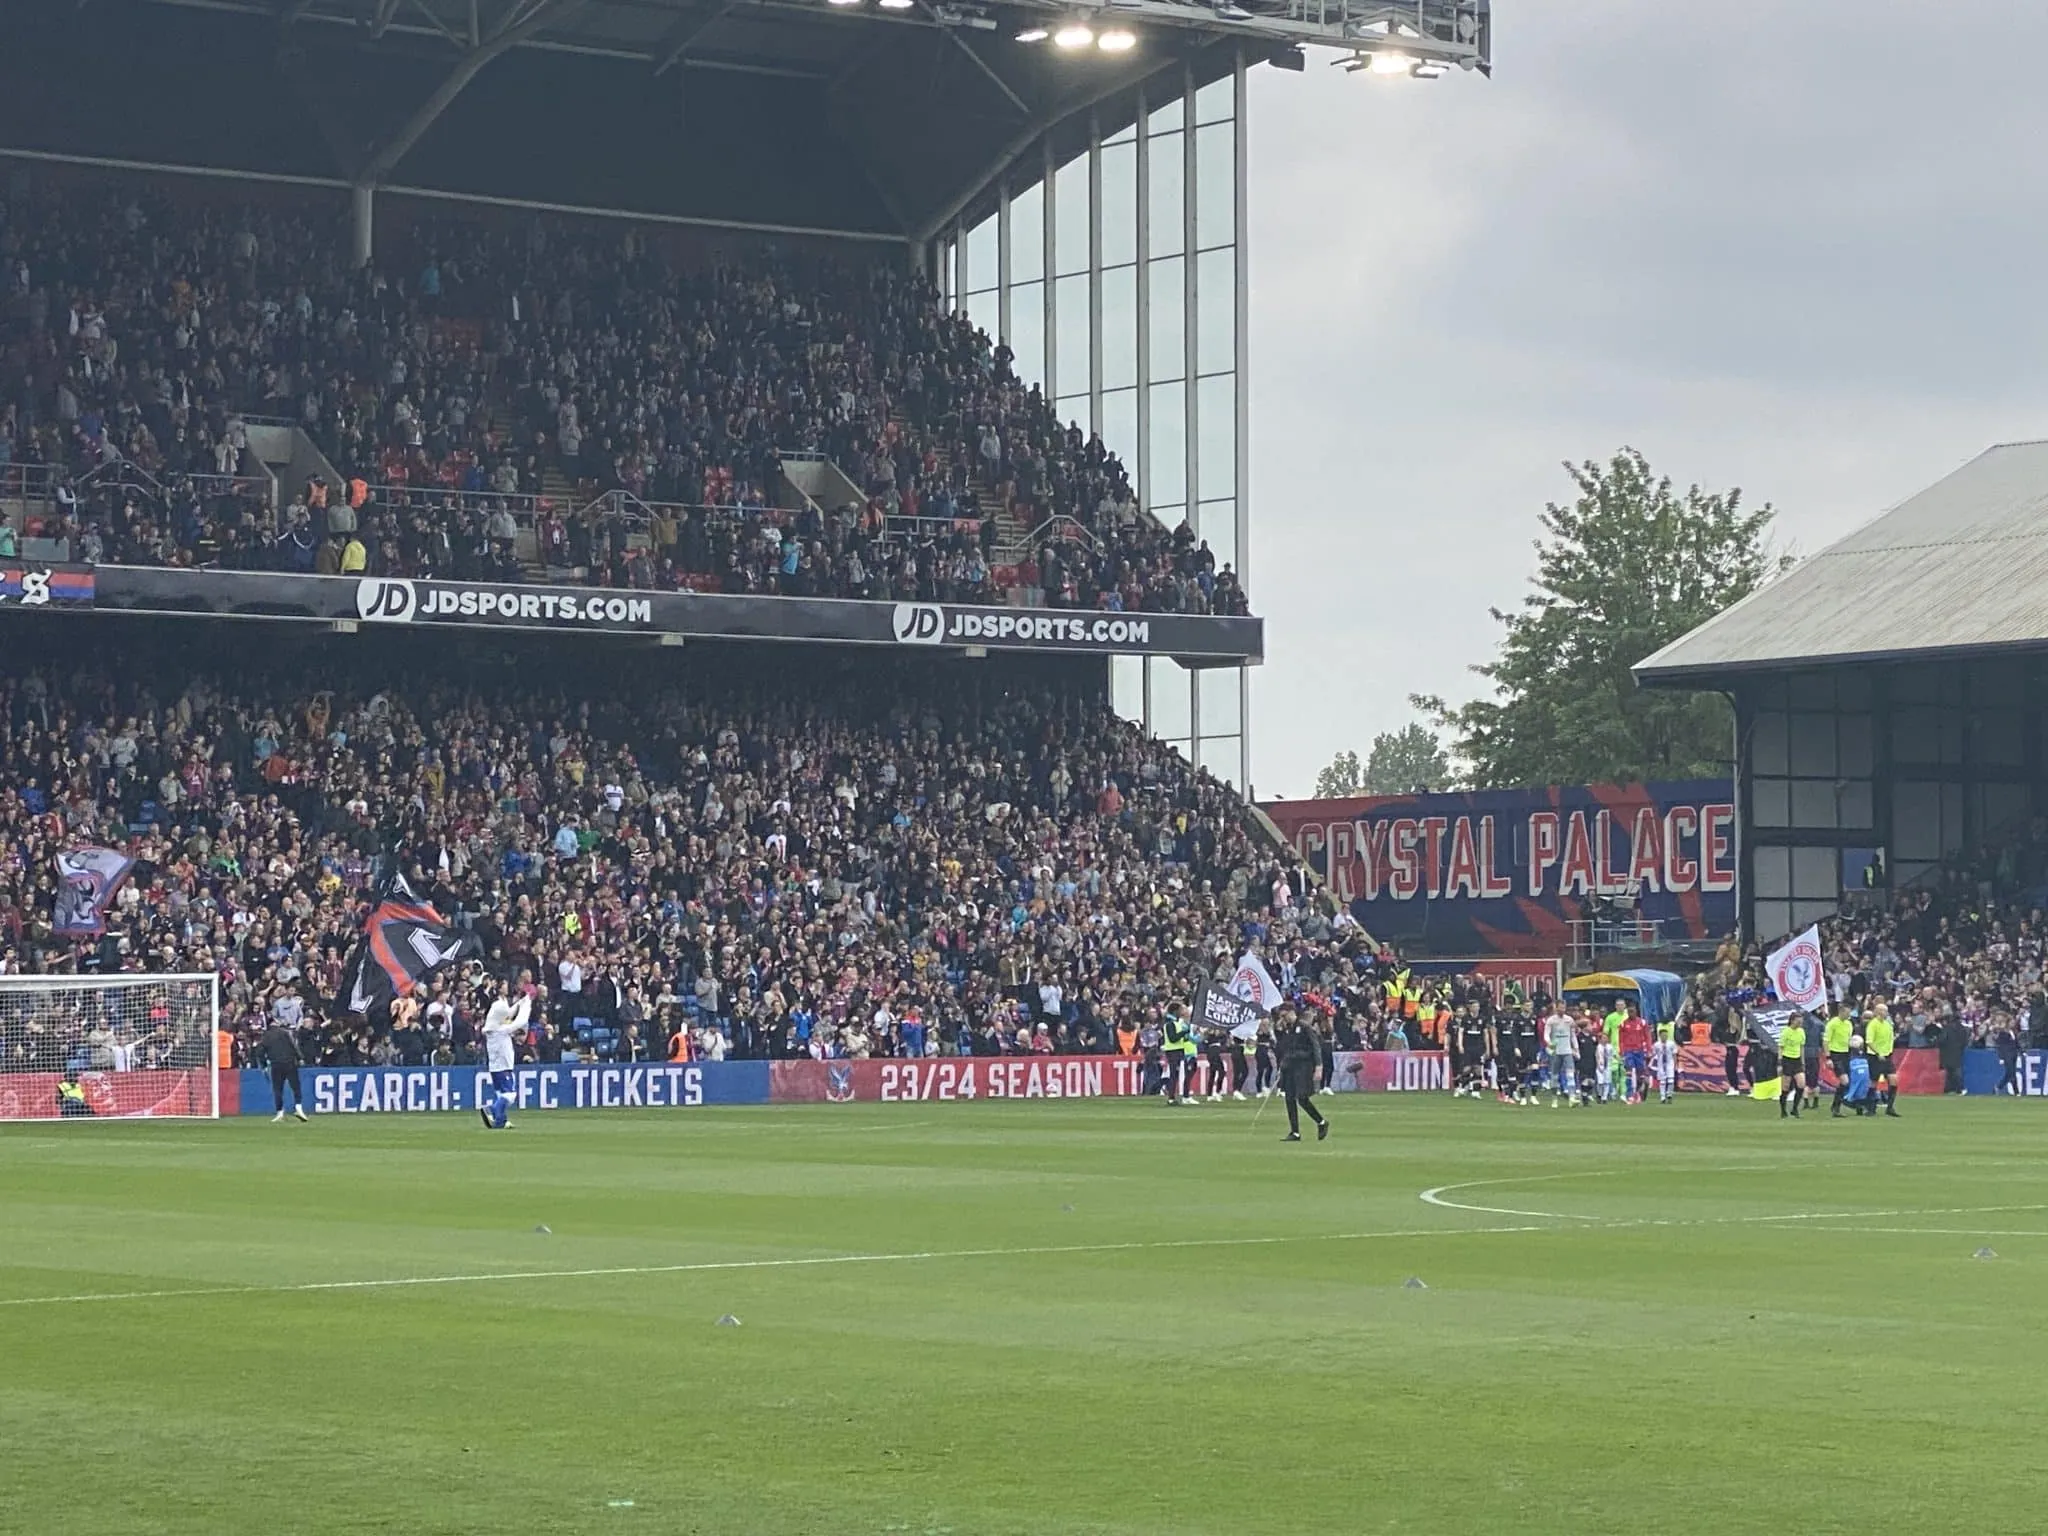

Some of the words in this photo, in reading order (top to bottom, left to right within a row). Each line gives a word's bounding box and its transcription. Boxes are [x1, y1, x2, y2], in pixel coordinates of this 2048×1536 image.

[421, 590, 651, 622] JDSPORTS.COM
[949, 614, 1149, 643] JDSPORTS.COM
[1297, 815, 1511, 901] CRYSTAL
[1528, 804, 1735, 897] PALACE
[315, 1071, 461, 1113] SEARCH:
[474, 1069, 558, 1111] CFC
[571, 1067, 703, 1109] TICKETS
[880, 1063, 977, 1101] 23/24
[988, 1062, 1101, 1099] SEASON
[1387, 1056, 1448, 1091] JOIN
